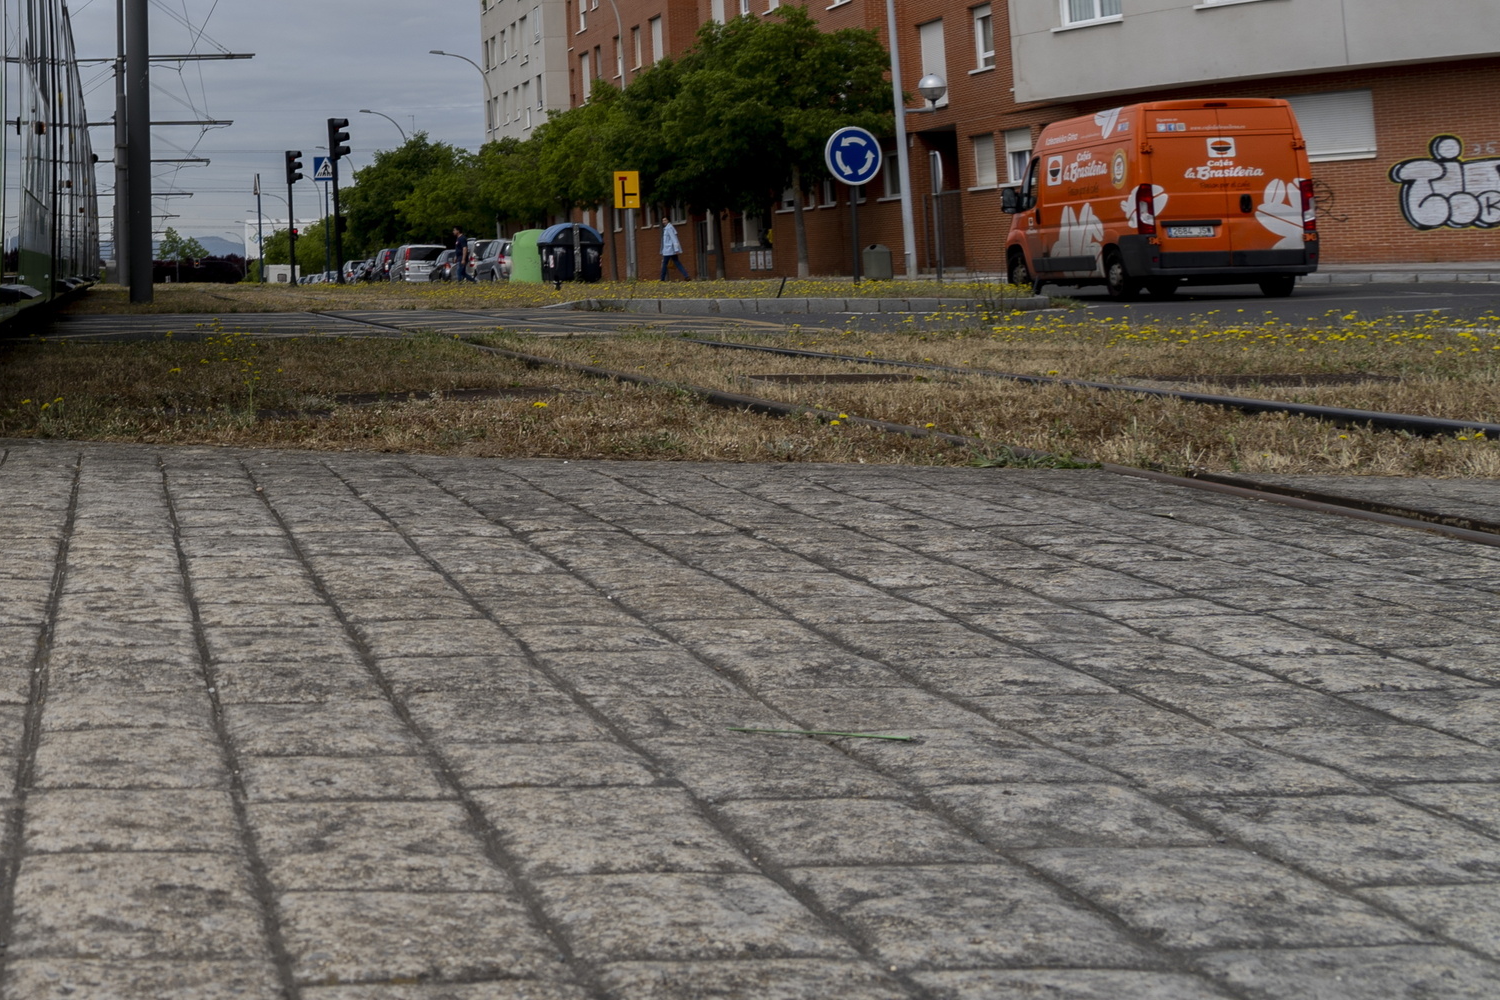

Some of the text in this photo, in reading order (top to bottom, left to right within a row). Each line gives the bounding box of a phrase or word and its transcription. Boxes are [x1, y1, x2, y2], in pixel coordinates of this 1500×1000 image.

[1076, 150, 1092, 162] Cafés
[1206, 159, 1234, 168] Cafés
[1070, 159, 1108, 183] Brasileña
[1184, 165, 1264, 180] la Brasileña
